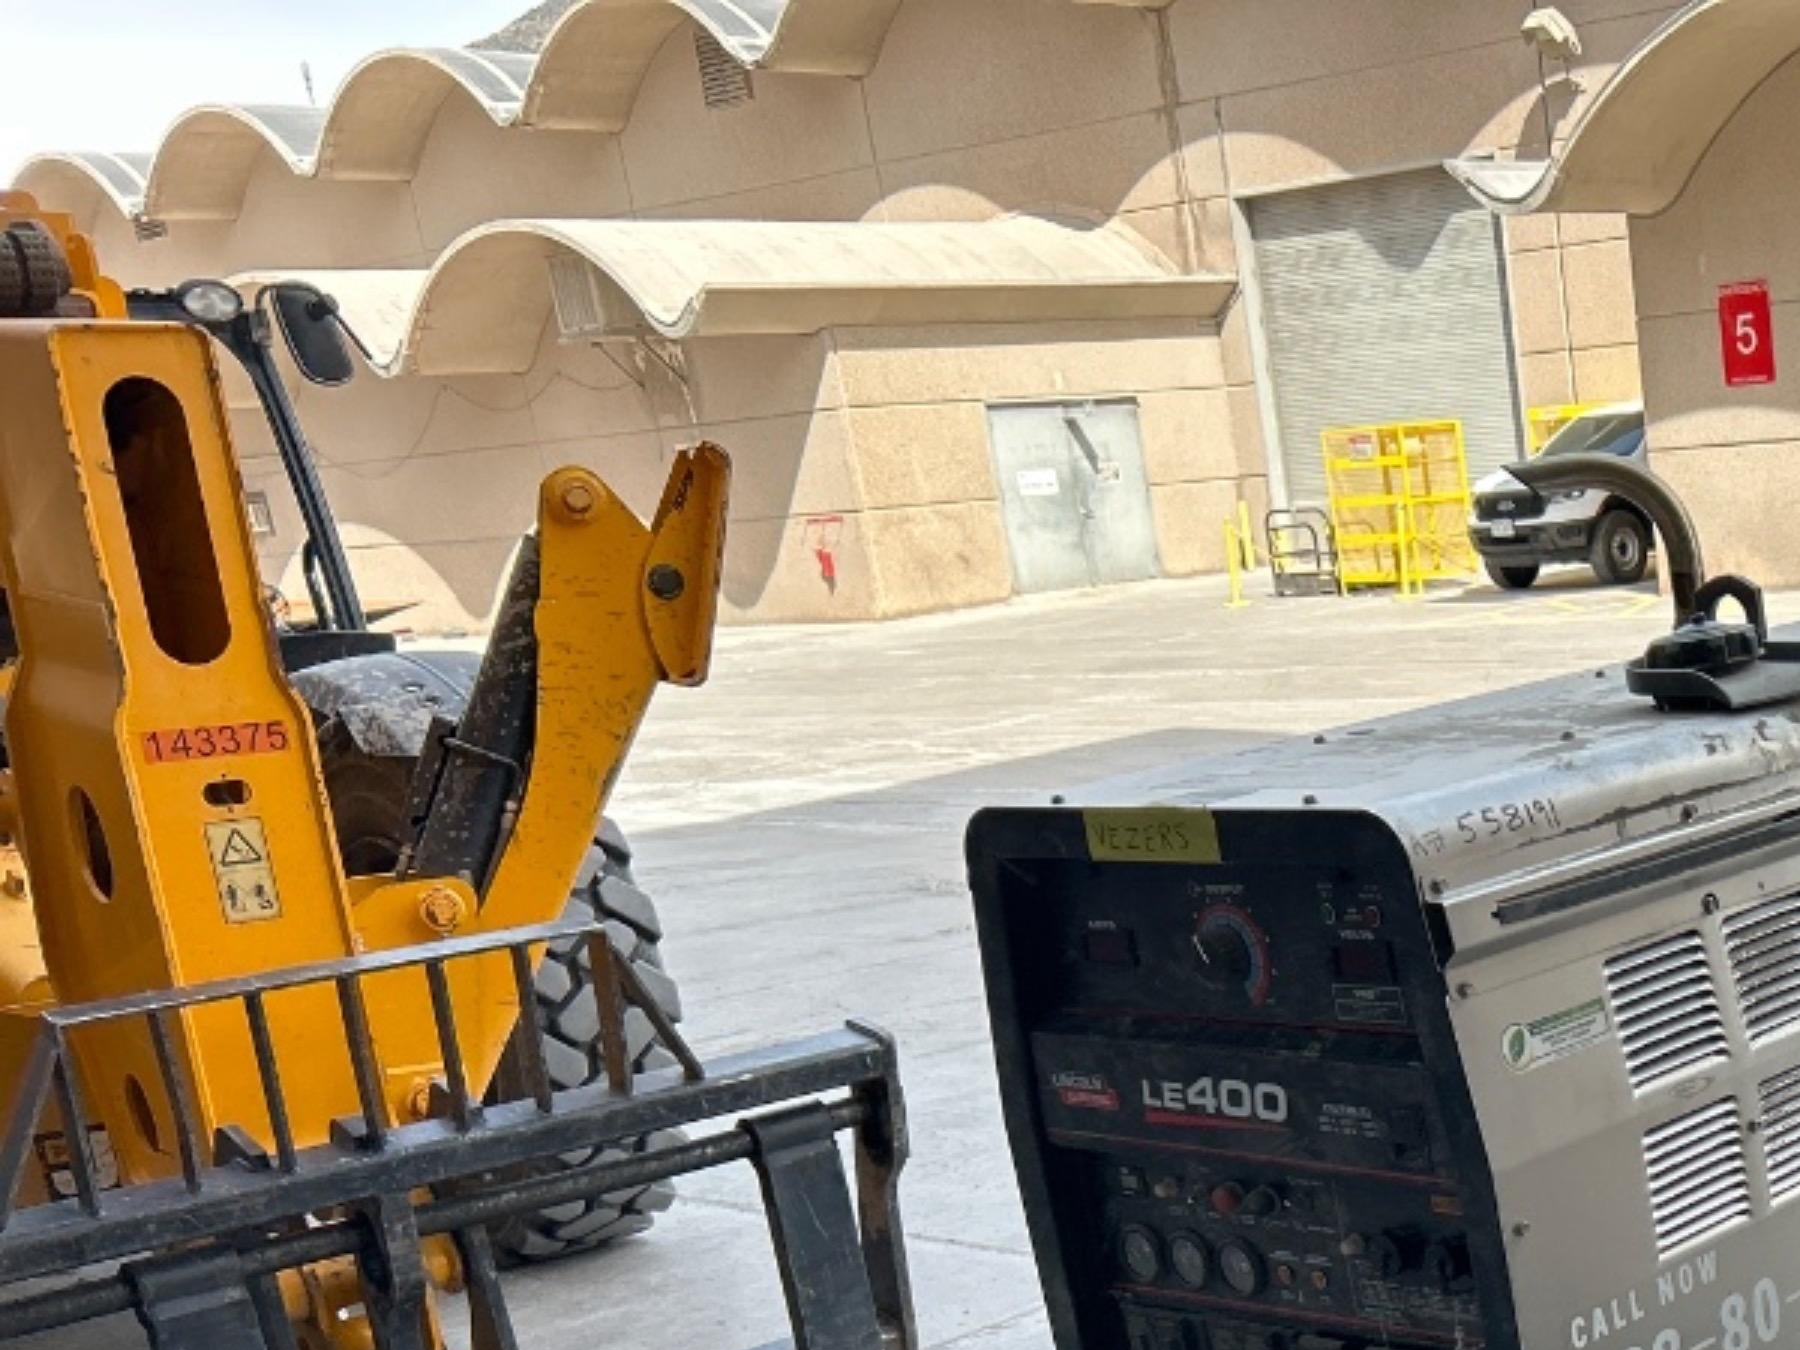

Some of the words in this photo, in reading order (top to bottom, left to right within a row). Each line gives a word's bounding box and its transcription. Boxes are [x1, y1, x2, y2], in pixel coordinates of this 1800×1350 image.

[1735, 312, 1758, 355] 5
[147, 721, 288, 760] 143375
[1094, 821, 1189, 852] VEZERS
[1142, 1076, 1288, 1123] LE400
[1571, 1289, 1646, 1350] CALL
[1657, 1250, 1719, 1307] NOW
